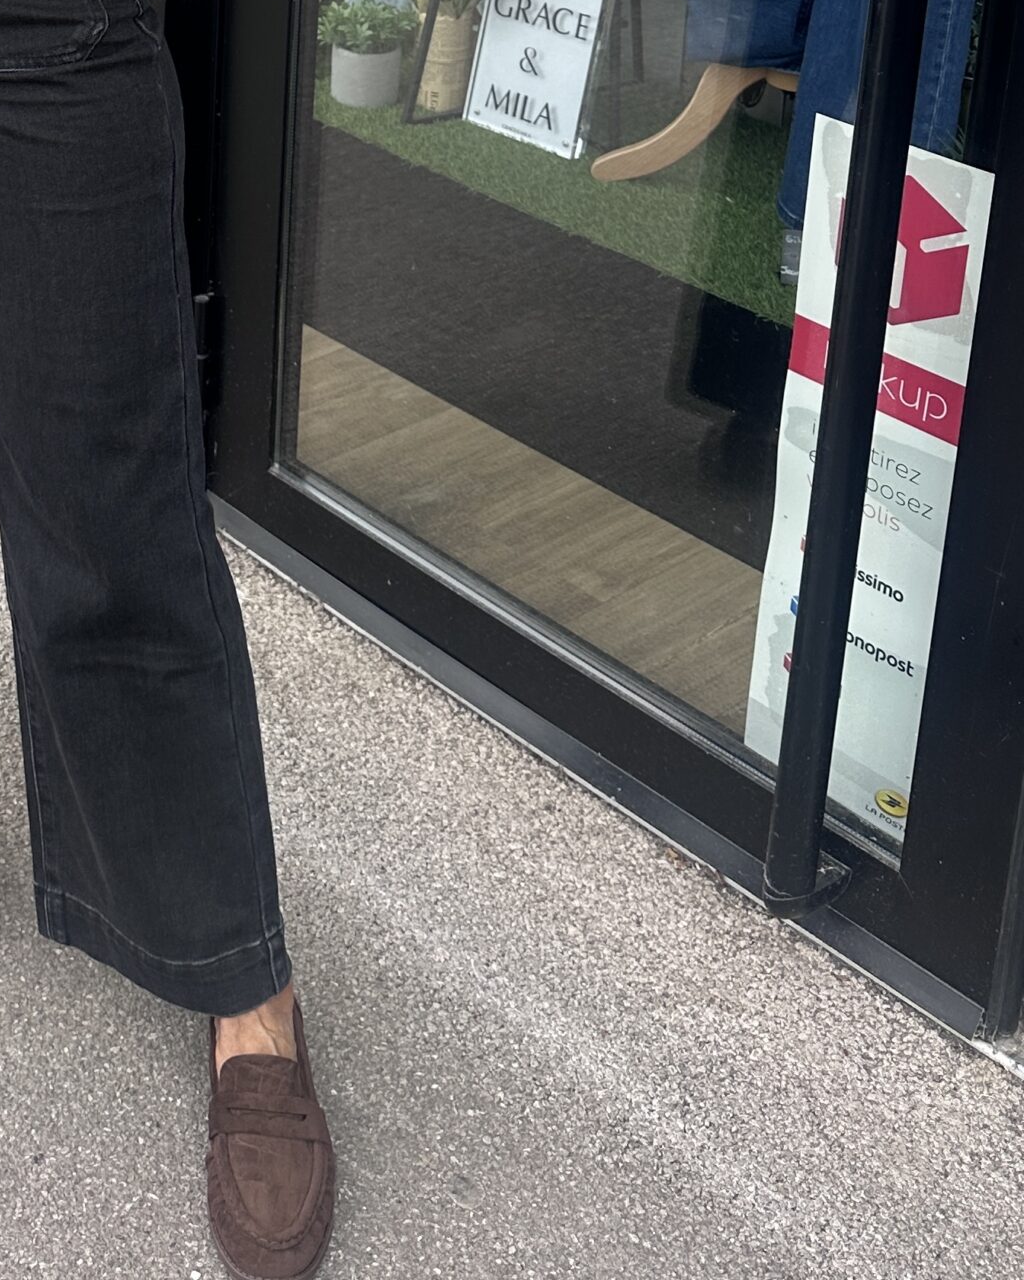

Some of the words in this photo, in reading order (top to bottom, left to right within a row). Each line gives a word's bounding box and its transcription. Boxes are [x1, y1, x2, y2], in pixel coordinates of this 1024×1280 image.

[519, 46, 539, 77] &
[484, 83, 552, 131] MILA
[878, 362, 948, 422] kup
[871, 447, 921, 486] tirez
[863, 503, 901, 532] olis
[865, 476, 934, 520] posez
[856, 569, 904, 603] ssimo
[846, 631, 914, 678] onopost
[865, 804, 877, 816] LA
[879, 813, 904, 831] POST
